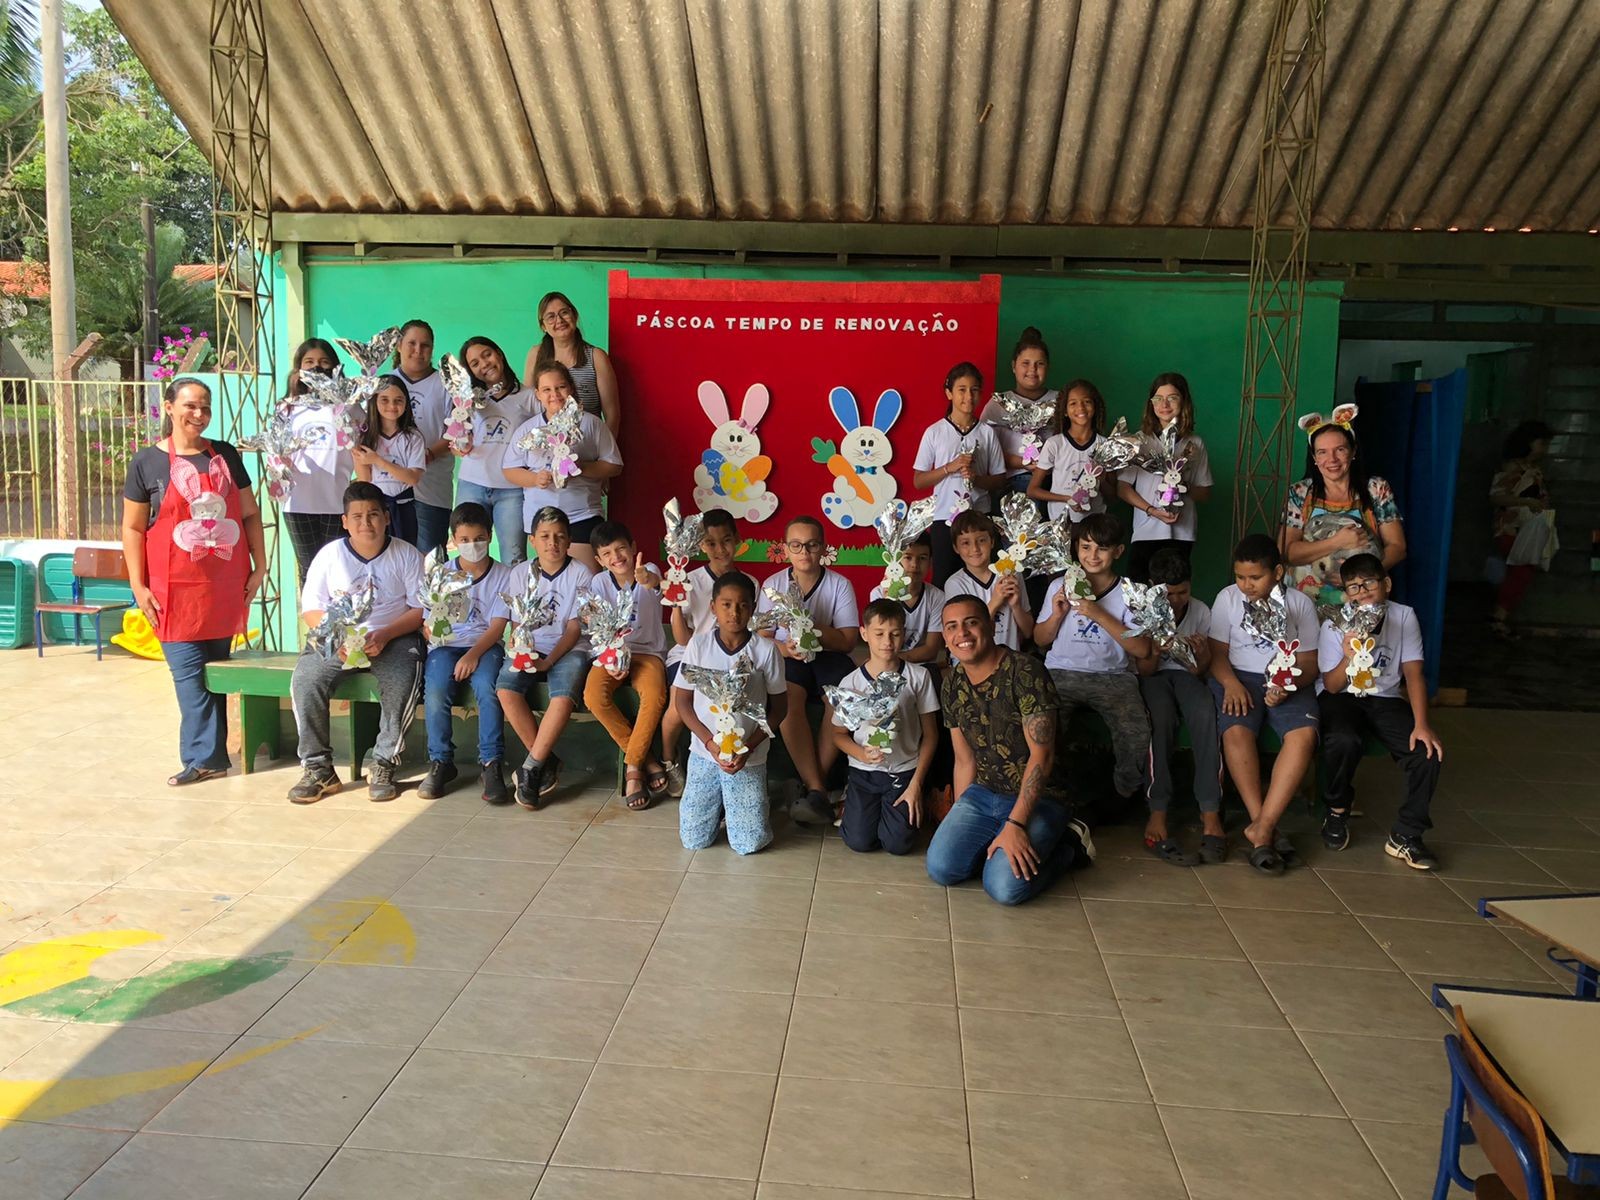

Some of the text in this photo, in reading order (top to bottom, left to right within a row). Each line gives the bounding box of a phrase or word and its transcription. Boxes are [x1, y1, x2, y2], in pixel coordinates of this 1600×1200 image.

[636, 309, 959, 337] PÁSCOA TEMPO DE RENOVAÇÃO
